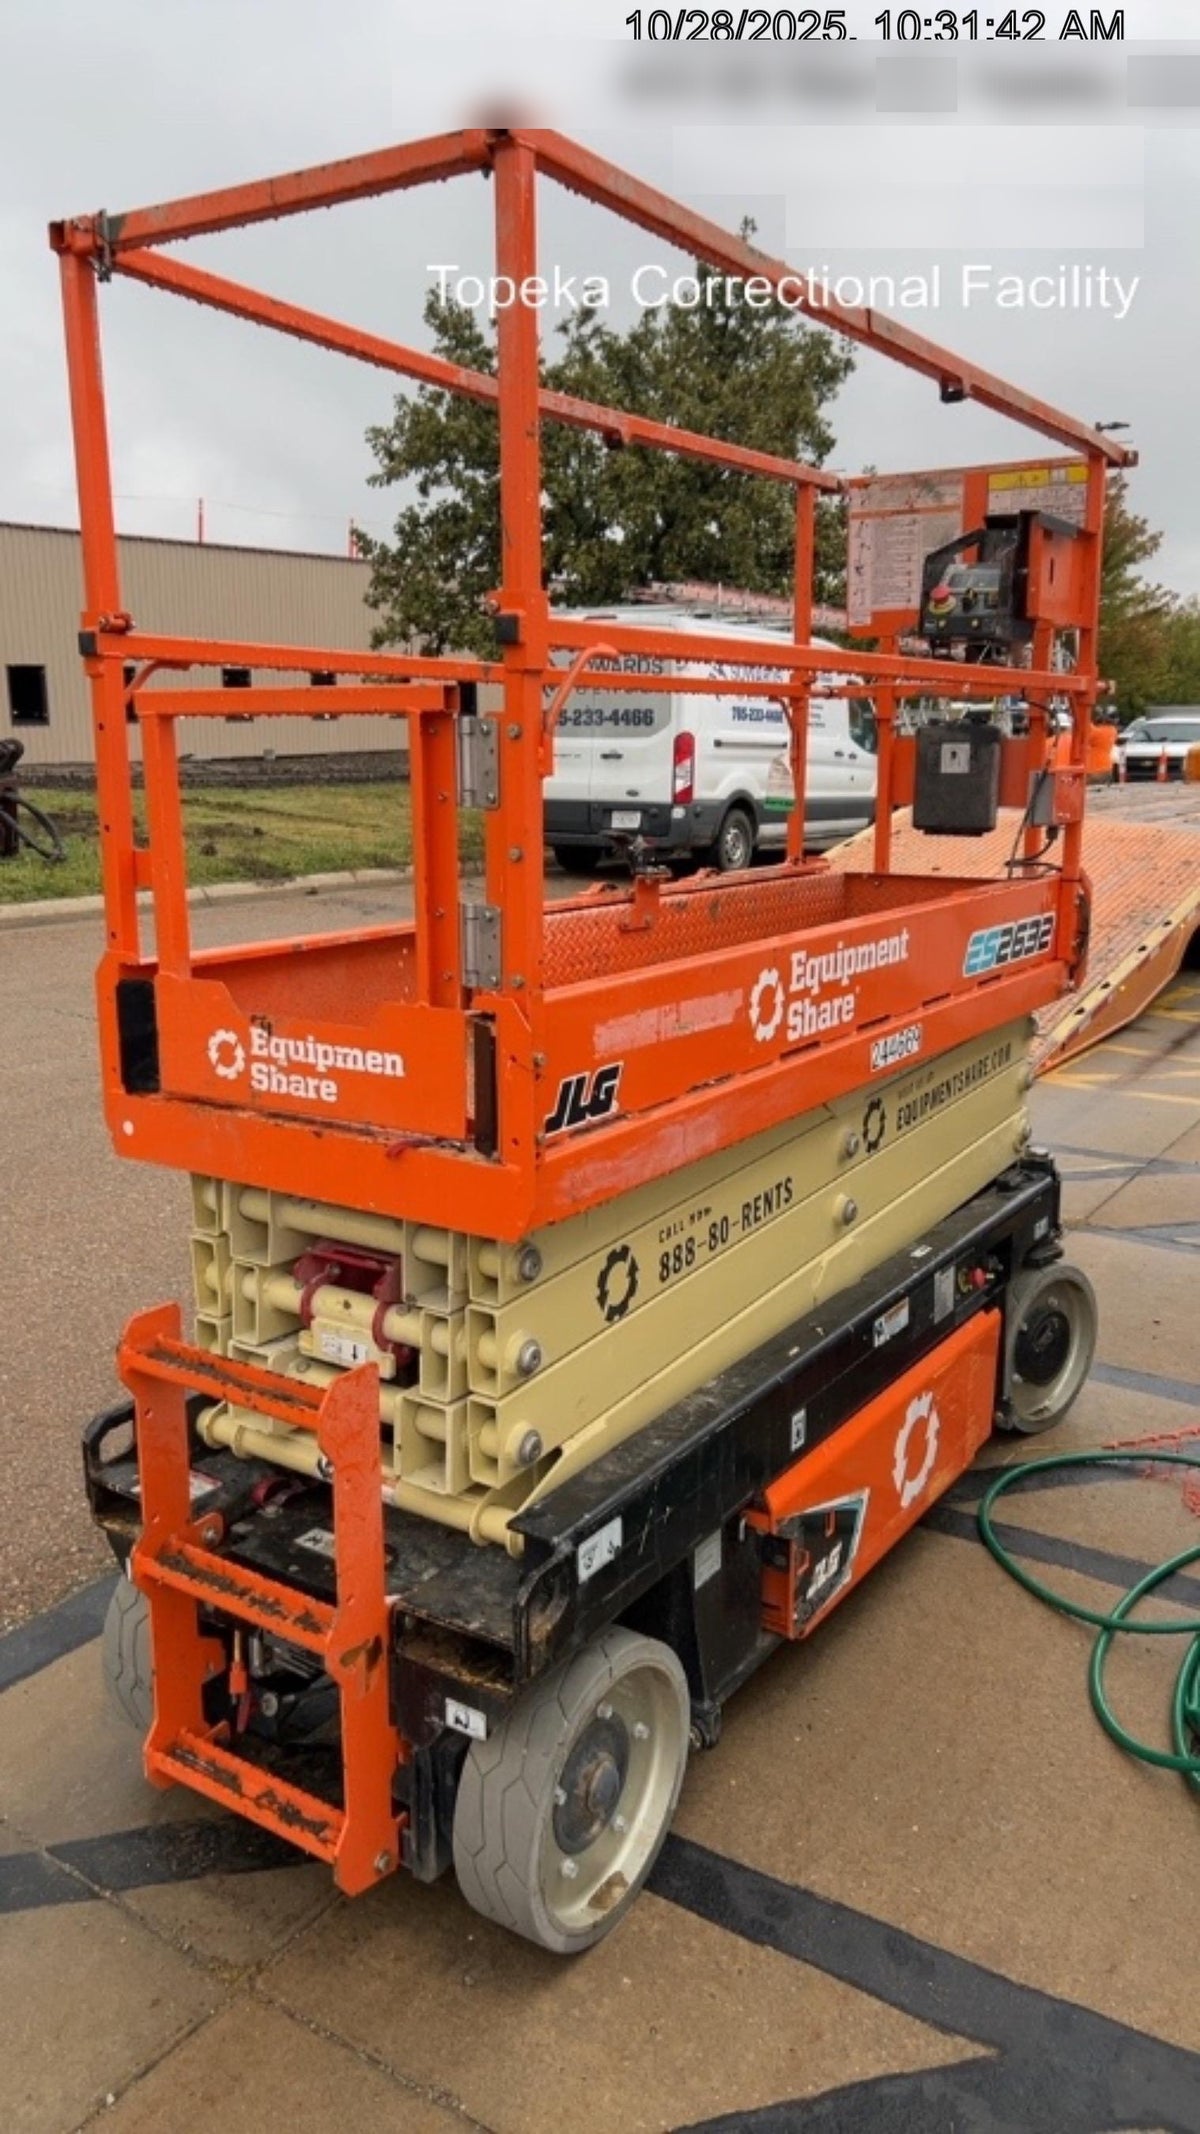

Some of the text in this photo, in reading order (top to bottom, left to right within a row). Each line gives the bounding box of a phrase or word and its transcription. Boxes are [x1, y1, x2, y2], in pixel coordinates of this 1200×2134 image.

[789, 926, 910, 997] Equipment
[963, 910, 1056, 978] ES2632
[786, 992, 856, 1042] Share
[249, 1025, 406, 1078] Equipmen
[250, 1061, 339, 1104] Share
[543, 1062, 623, 1138] JLG
[896, 1041, 1011, 1132] EQUIPMENTSHARE.COM
[658, 1176, 793, 1283] 888-80-RENTS
[658, 1219, 685, 1244] CALL
